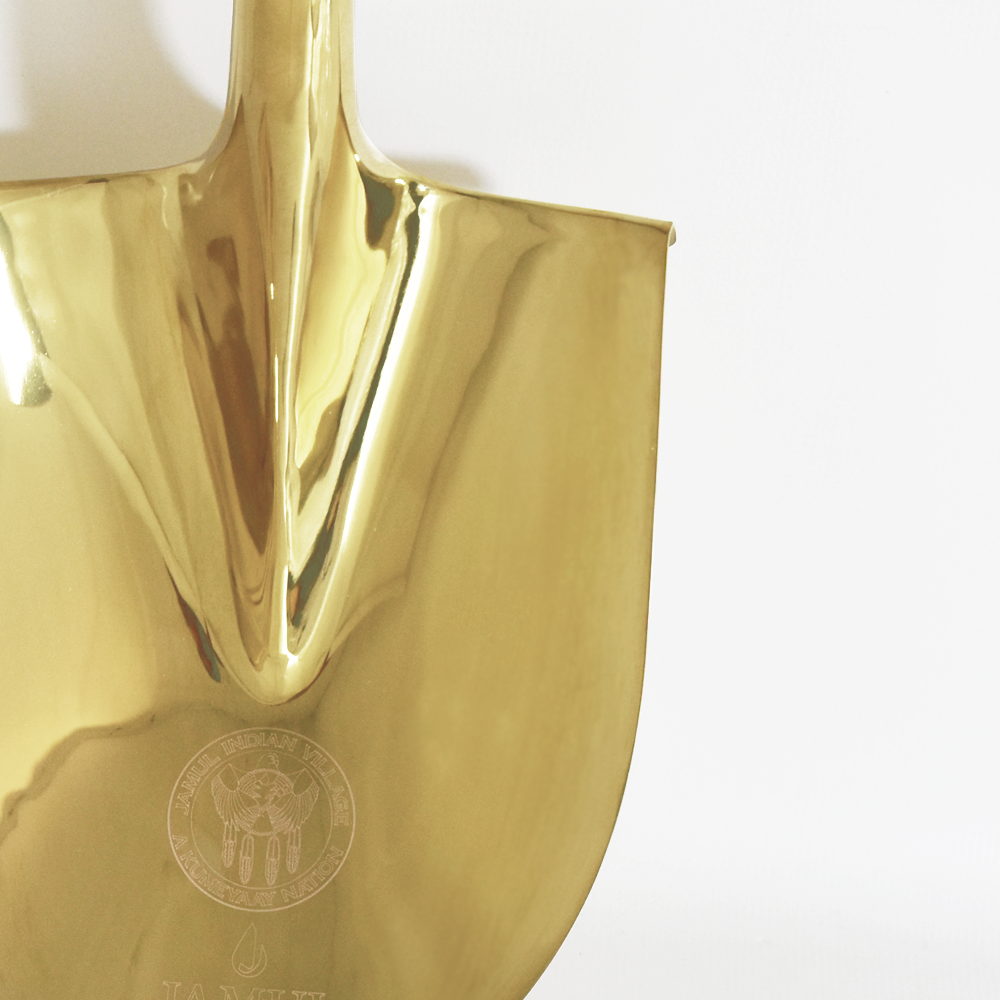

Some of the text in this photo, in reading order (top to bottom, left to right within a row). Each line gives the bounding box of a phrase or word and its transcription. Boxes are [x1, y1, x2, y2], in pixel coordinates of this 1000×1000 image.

[175, 732, 349, 826] JAMUL INDIAN VILLAGE
[171, 834, 344, 907] A KUMEYAAY NATION
